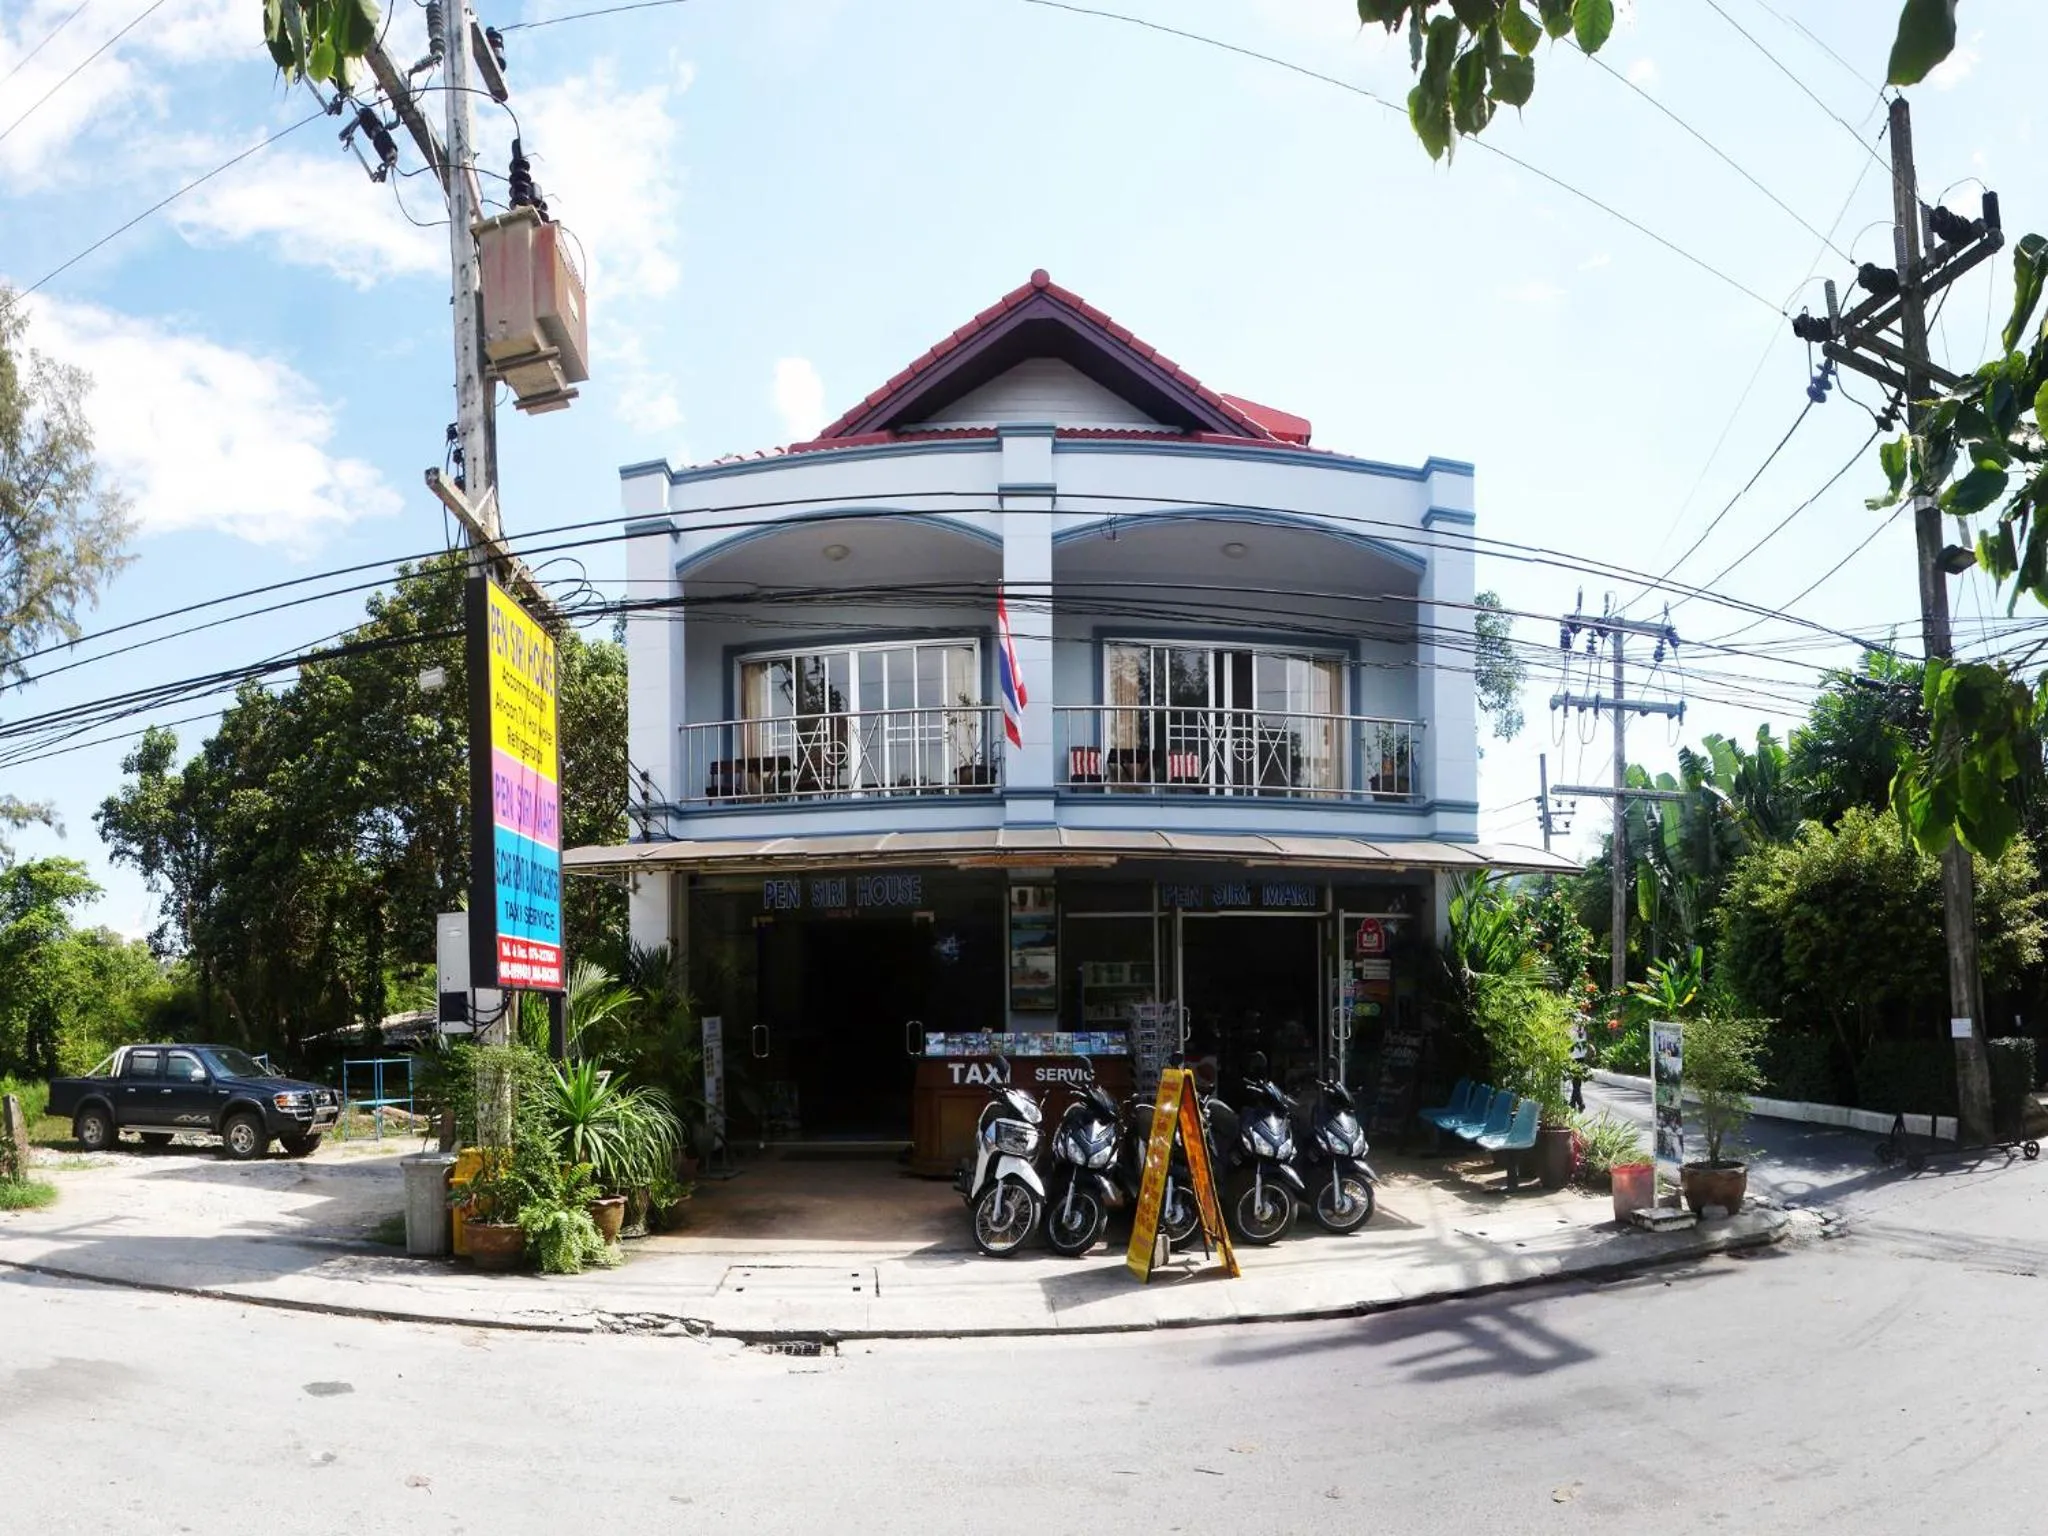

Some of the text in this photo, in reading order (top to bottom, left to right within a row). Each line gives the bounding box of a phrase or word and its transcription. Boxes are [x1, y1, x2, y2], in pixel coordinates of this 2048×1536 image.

[491, 603, 553, 697] PEN SIRI HOUSE
[495, 771, 556, 839] PEN SIRI MART
[763, 874, 923, 909] PEN SIRI HOUSE
[1162, 883, 1204, 908] PEN
[1261, 881, 1317, 907] MART
[504, 900, 554, 931] TAXI SERVICE
[947, 1062, 1011, 1085] TAXI
